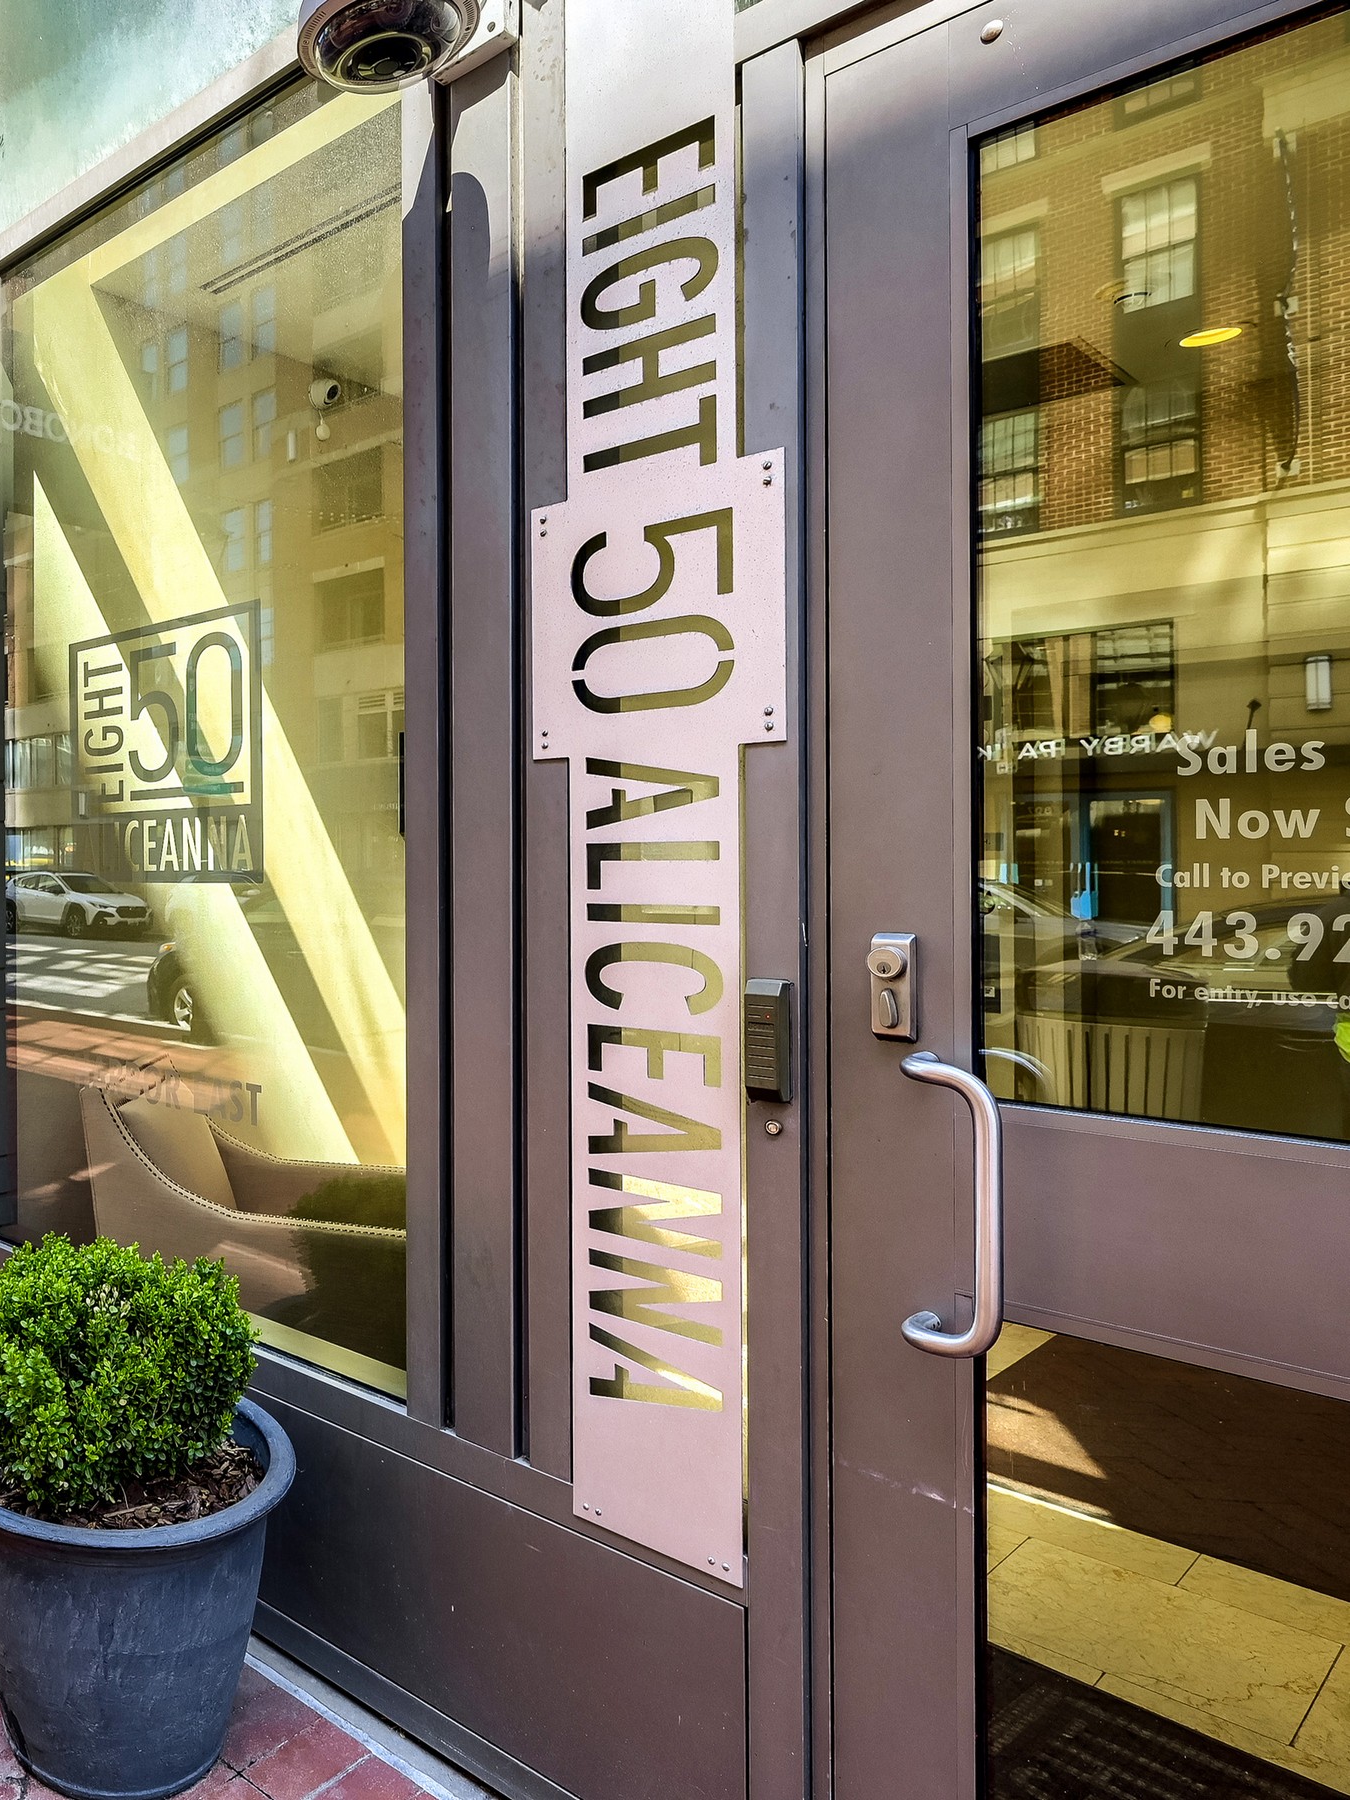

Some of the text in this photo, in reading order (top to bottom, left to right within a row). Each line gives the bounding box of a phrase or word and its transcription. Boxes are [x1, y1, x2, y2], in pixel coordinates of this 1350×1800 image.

[83, 661, 124, 803] EIGHT
[128, 631, 243, 783] 50
[570, 114, 735, 1413] EIGHT 50 ALICEANNA
[1176, 729, 1326, 776] Sales
[84, 814, 254, 873] ICEANNA
[1195, 798, 1321, 840] Now
[1155, 862, 1210, 889] Call
[1219, 867, 1251, 889] to
[1149, 978, 1187, 999] For
[1194, 985, 1262, 1009] entry,
[1272, 992, 1317, 1008] use
